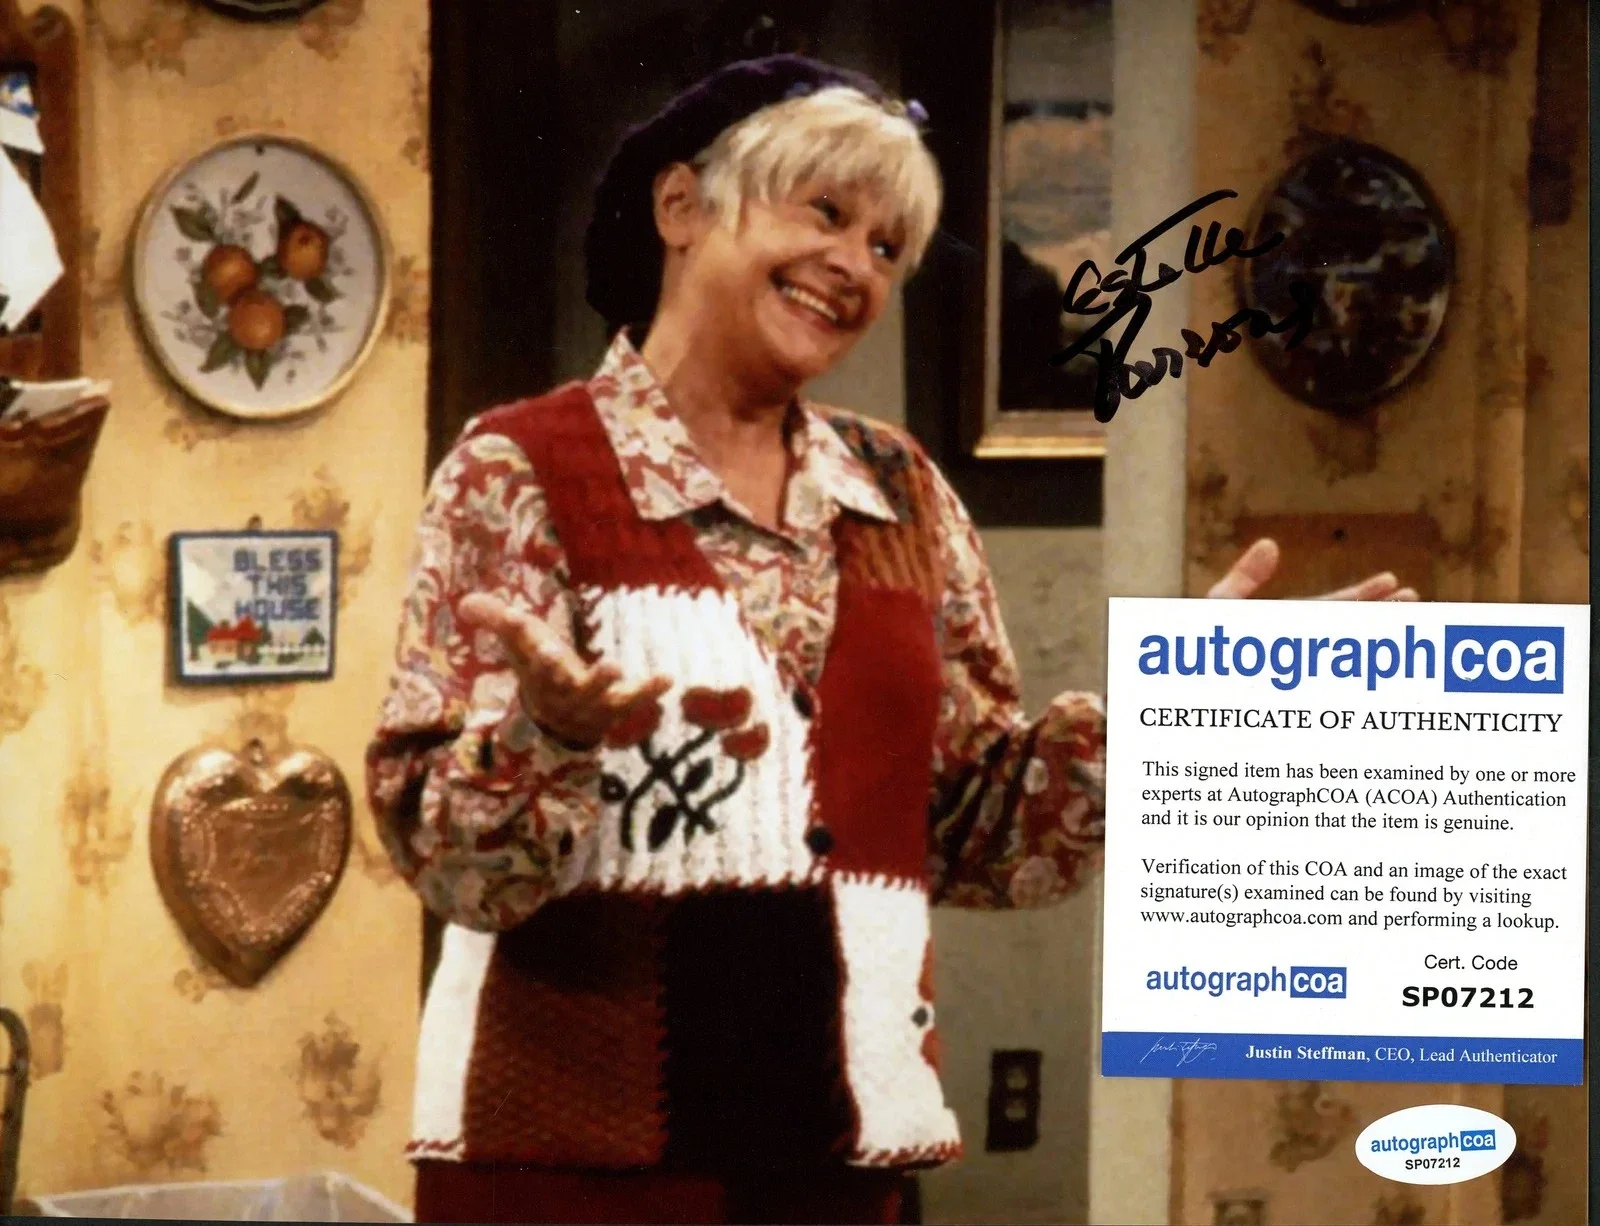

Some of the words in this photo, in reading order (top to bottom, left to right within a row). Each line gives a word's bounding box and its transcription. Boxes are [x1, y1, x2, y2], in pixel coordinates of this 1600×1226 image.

[233, 549, 322, 572] BLESS
[246, 574, 307, 595] THIS
[234, 598, 320, 620] HOUSE
[1140, 708, 1311, 728] CERTIFICATE
[1320, 711, 1355, 729] OF
[1361, 712, 1562, 732] AUTHENTICITY
[1143, 761, 1178, 776] This
[1185, 762, 1238, 781] signed
[1245, 762, 1280, 777] item
[1286, 763, 1313, 778] has
[1320, 764, 1358, 779] been
[1364, 765, 1443, 780] examined
[1450, 766, 1469, 785] by
[1476, 770, 1505, 781] one
[1511, 771, 1528, 781] or
[1534, 772, 1575, 782] more
[1142, 788, 1201, 804] experts
[1208, 789, 1222, 801] at
[1228, 787, 1359, 806] AutographCOA
[1366, 789, 1437, 808] (ACOA)
[1443, 790, 1566, 806] Authentication
[1142, 810, 1171, 824] and
[1178, 810, 1188, 825] it
[1195, 810, 1207, 825] is
[1213, 815, 1240, 826] our
[1246, 811, 1308, 830] opinion
[1315, 812, 1346, 827] that
[1352, 813, 1376, 828] the
[1383, 813, 1418, 828] item
[1425, 814, 1437, 829] is
[1444, 815, 1513, 833] genuine.
[1141, 859, 1240, 874] Verification
[1247, 860, 1266, 875] of
[1269, 860, 1299, 875] this
[1305, 861, 1347, 876] COA
[1354, 862, 1383, 877] and
[1389, 867, 1408, 877] an
[1415, 863, 1464, 882] image
[1470, 863, 1489, 878] of
[1493, 864, 1517, 879] the
[1524, 867, 1567, 879] exact
[1141, 883, 1238, 902] signature(s)
[1245, 885, 1324, 900] examined
[1331, 890, 1358, 901] can
[1365, 886, 1383, 901] be
[1390, 886, 1437, 902] found
[1443, 888, 1463, 906] by
[1469, 888, 1531, 908] visiting
[1141, 909, 1342, 928] www.autographcoa.com
[1349, 911, 1377, 925] and
[1384, 911, 1477, 931] performing
[1483, 917, 1491, 927] a
[1498, 913, 1558, 932] lookup.
[1425, 955, 1464, 969] Cert.
[1472, 955, 1518, 970] Code
[1403, 986, 1534, 1008] SP07212
[1246, 1046, 1291, 1058] Justin
[1298, 1046, 1370, 1062] Steffman,
[1376, 1048, 1414, 1063] CEO,
[1421, 1049, 1454, 1061] Lead
[1460, 1050, 1557, 1063] Authenticator
[1405, 1157, 1461, 1170] SP07212
